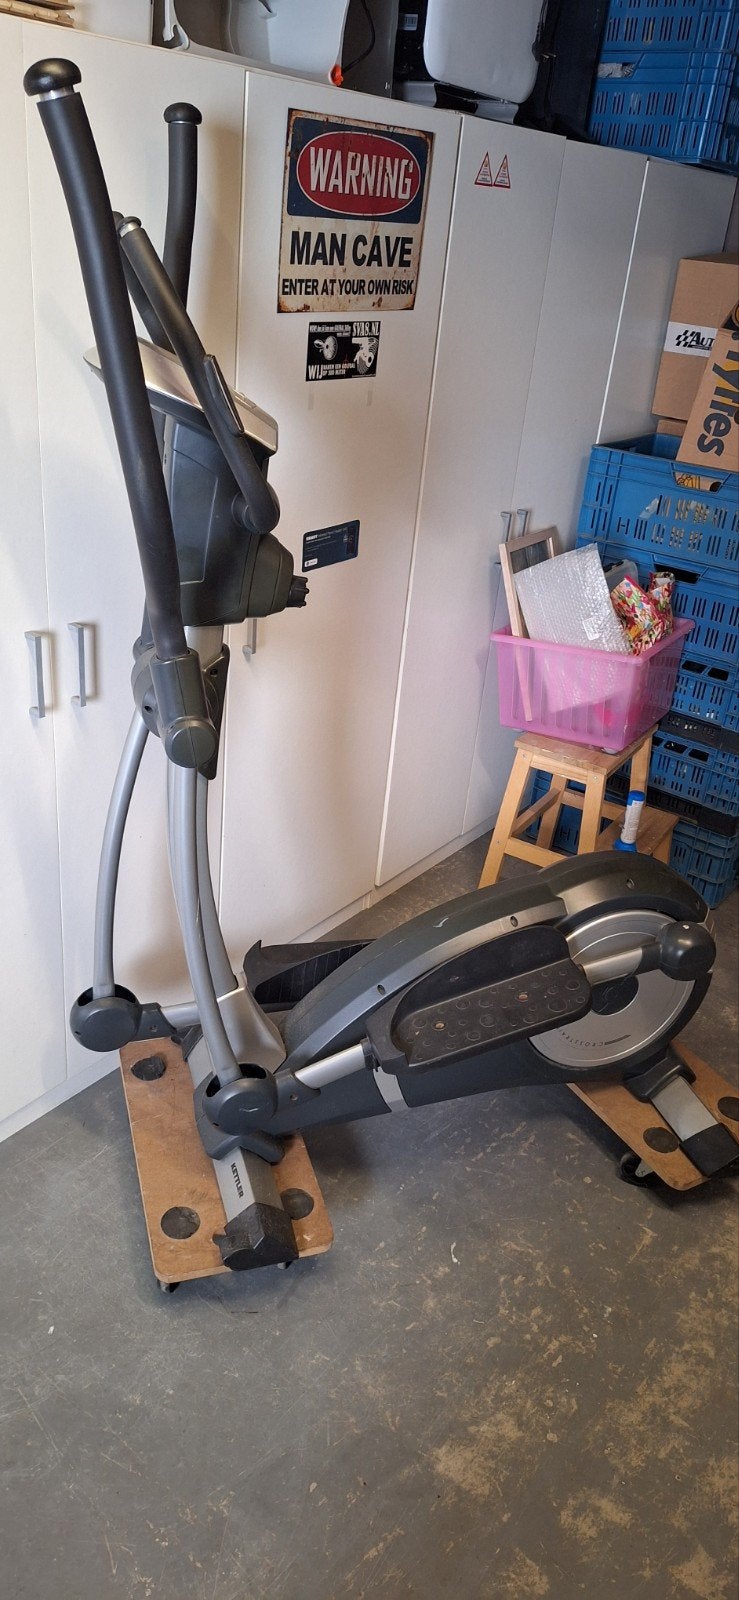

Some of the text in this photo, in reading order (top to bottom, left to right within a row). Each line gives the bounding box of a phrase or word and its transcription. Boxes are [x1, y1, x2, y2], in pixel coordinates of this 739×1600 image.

[309, 146, 413, 200] WARNING
[290, 231, 414, 267] MAN CAVE
[282, 278, 414, 296] ENTER AT YOUR OWN RISK
[308, 364, 323, 380] WIJ
[231, 1163, 244, 1198] KETTLER
